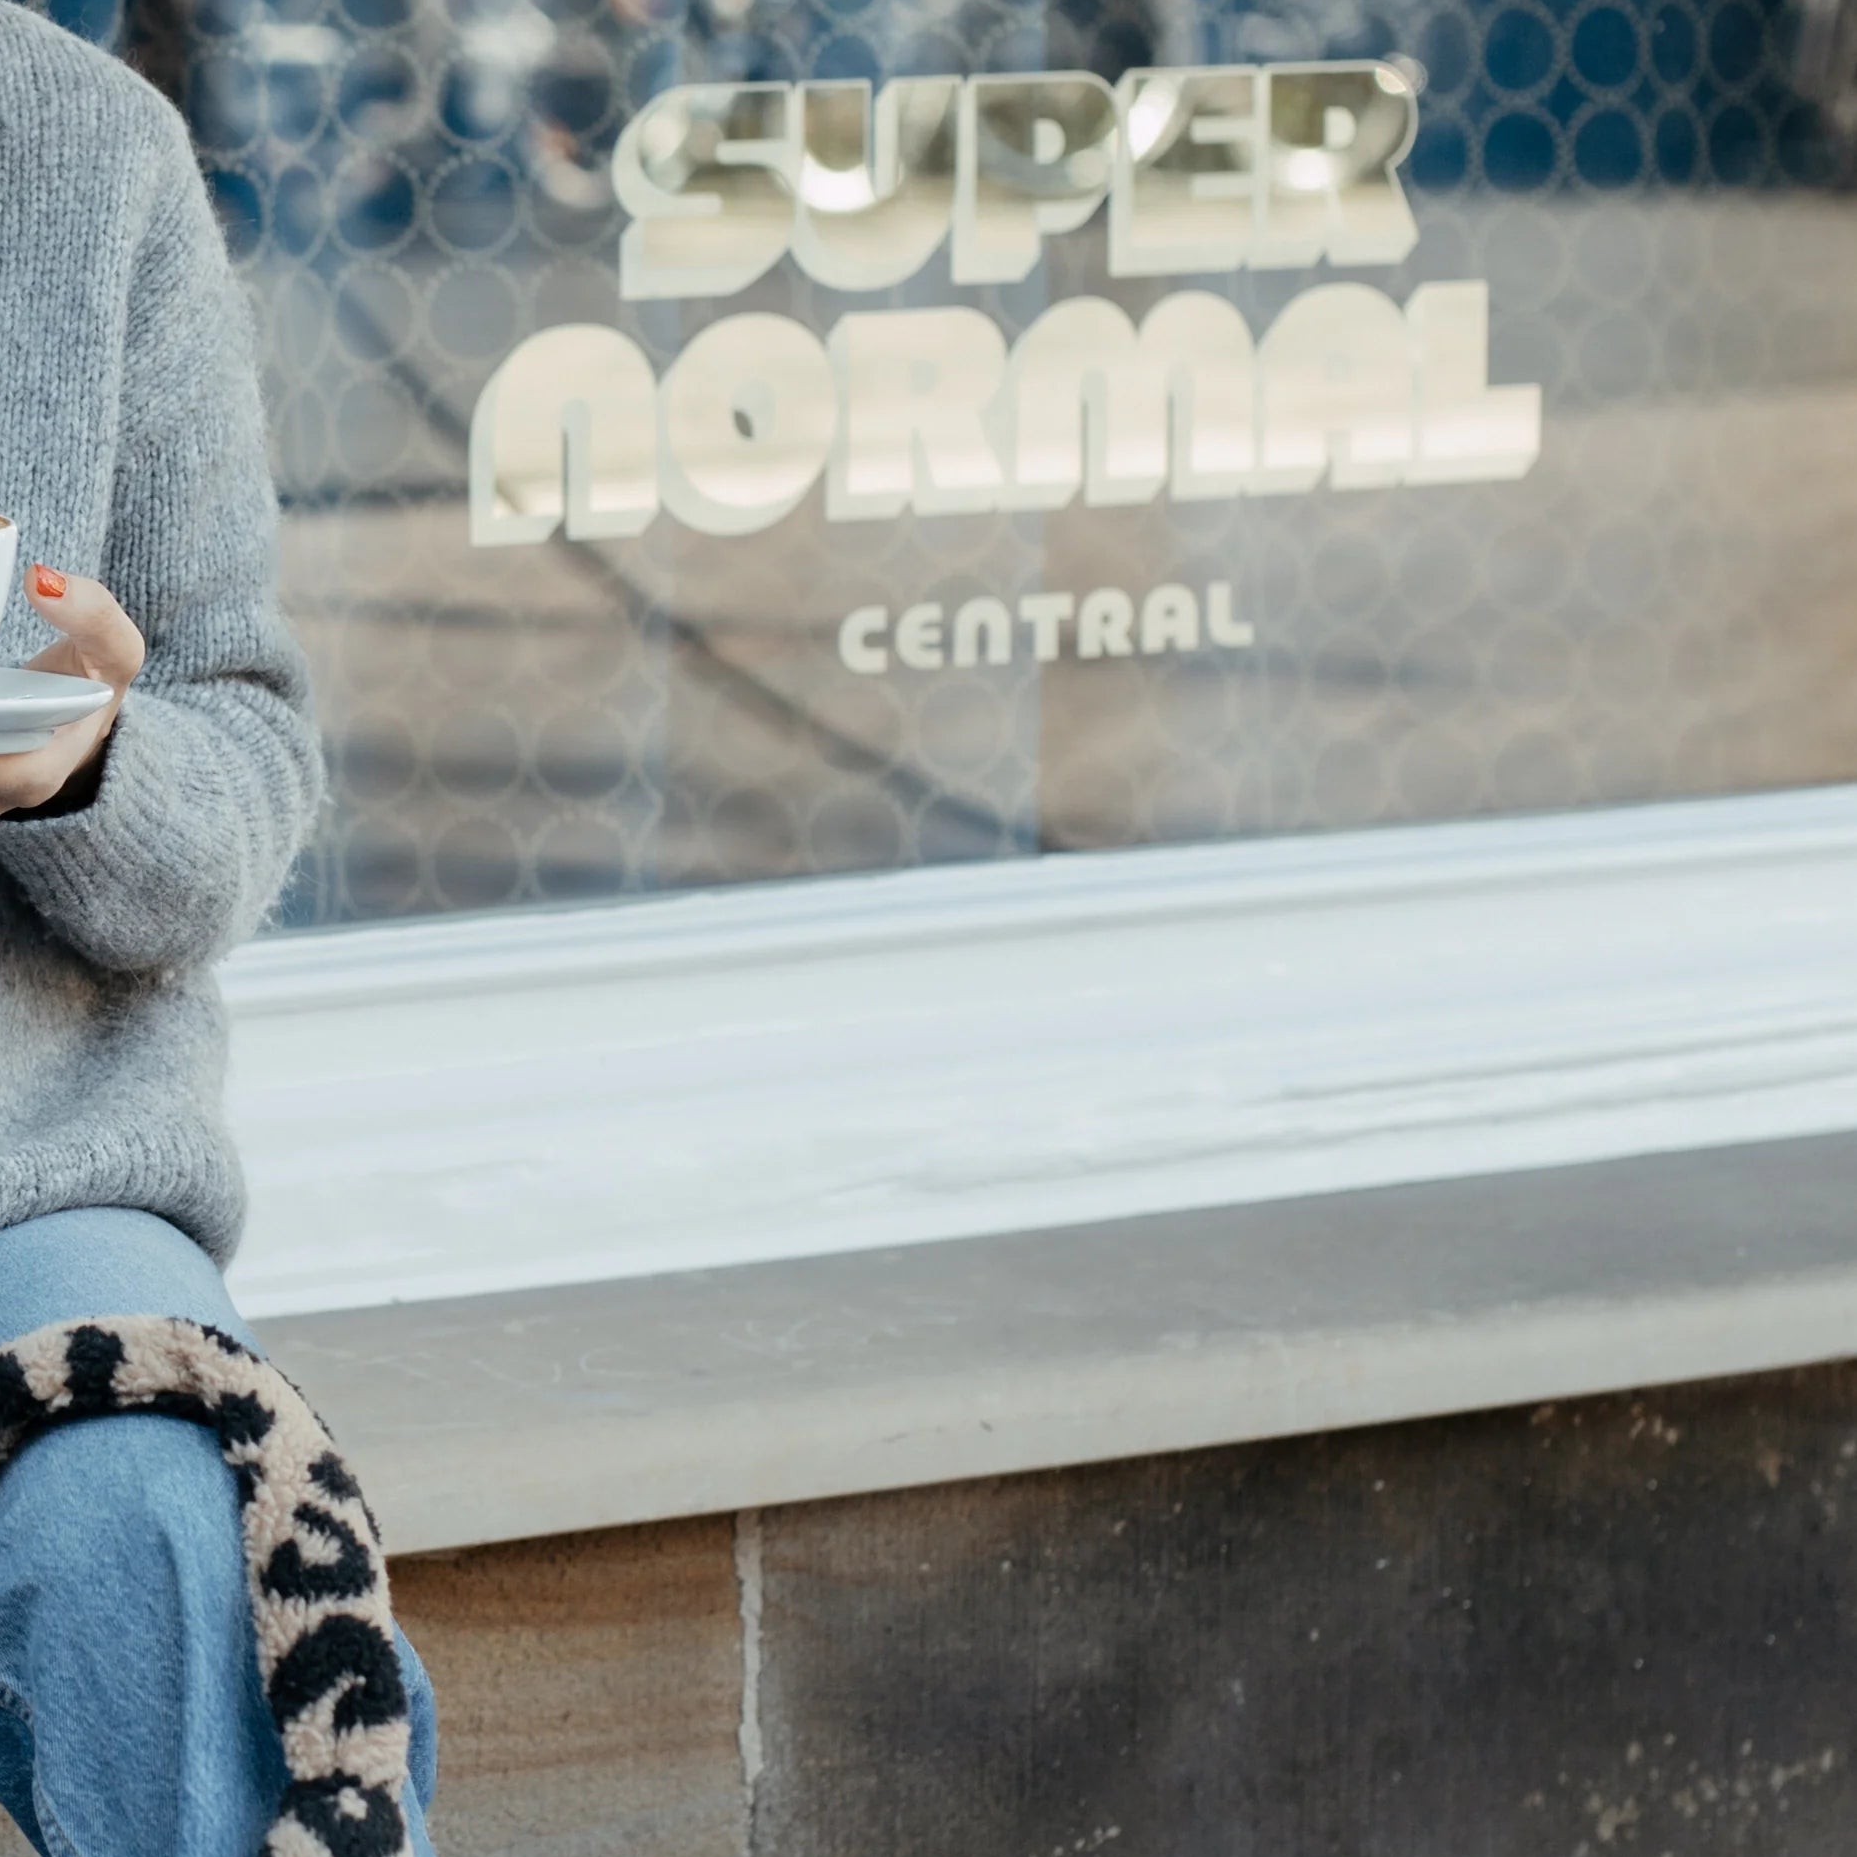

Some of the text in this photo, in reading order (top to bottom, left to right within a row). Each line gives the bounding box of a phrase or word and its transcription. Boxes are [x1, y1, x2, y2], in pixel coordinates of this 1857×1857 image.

[612, 58, 1420, 300] SUPER
[470, 279, 1541, 547] NORMAL
[838, 581, 1254, 675] CENTRAL
